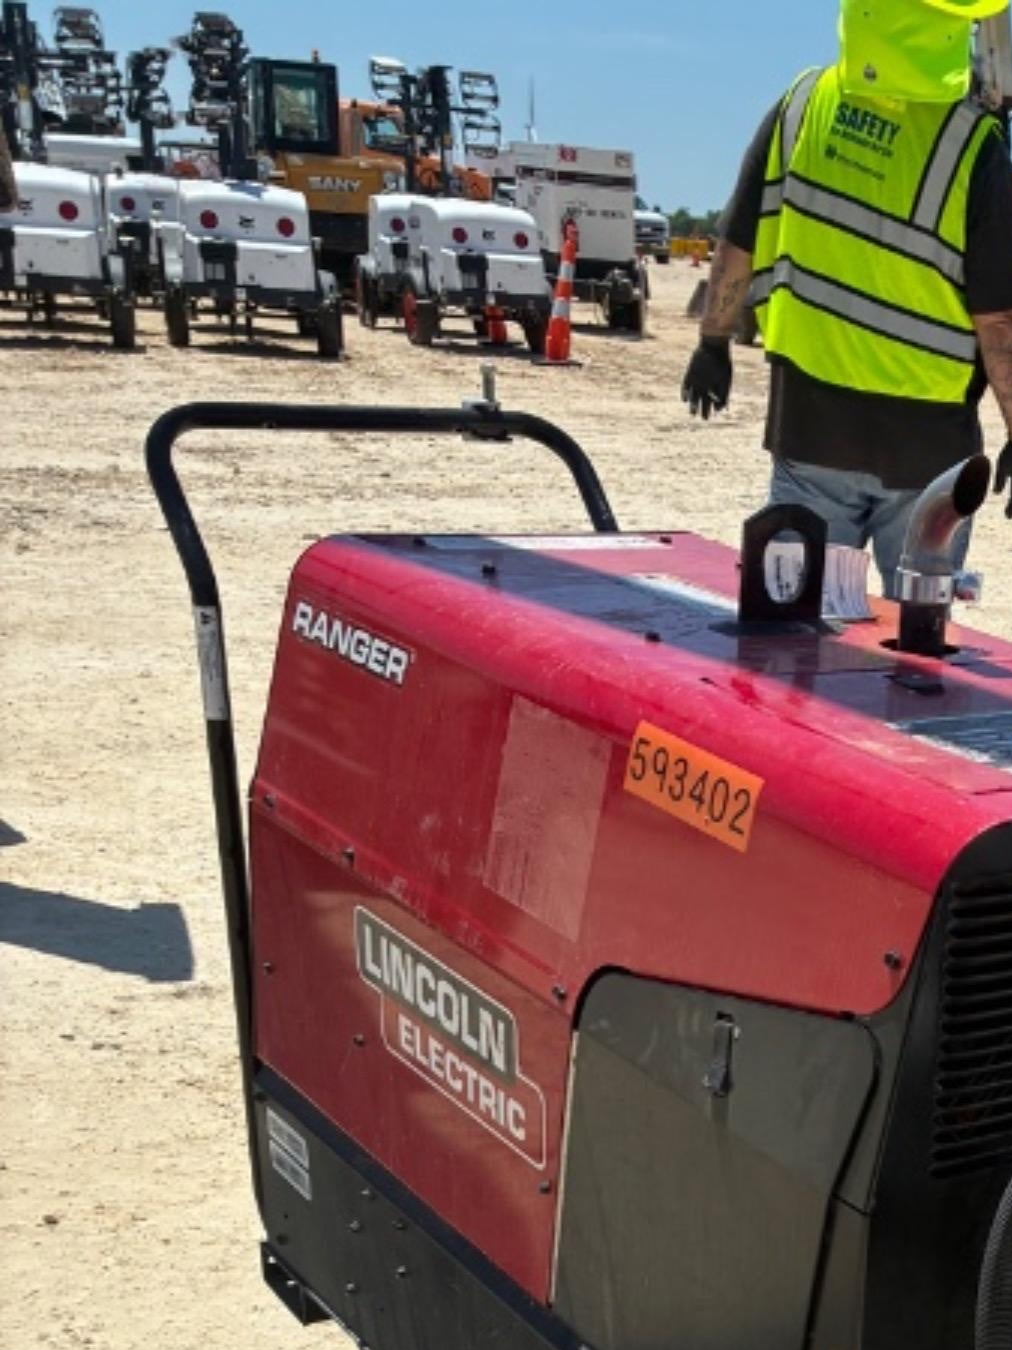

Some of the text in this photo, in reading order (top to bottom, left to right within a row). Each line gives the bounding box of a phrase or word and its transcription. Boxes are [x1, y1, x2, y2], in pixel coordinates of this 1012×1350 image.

[835, 102, 901, 145] SAFETY
[293, 602, 409, 685] RANGER
[629, 737, 751, 836] 593402
[363, 923, 506, 1073] LINCOLN
[397, 1012, 527, 1141] ELECTRIC
